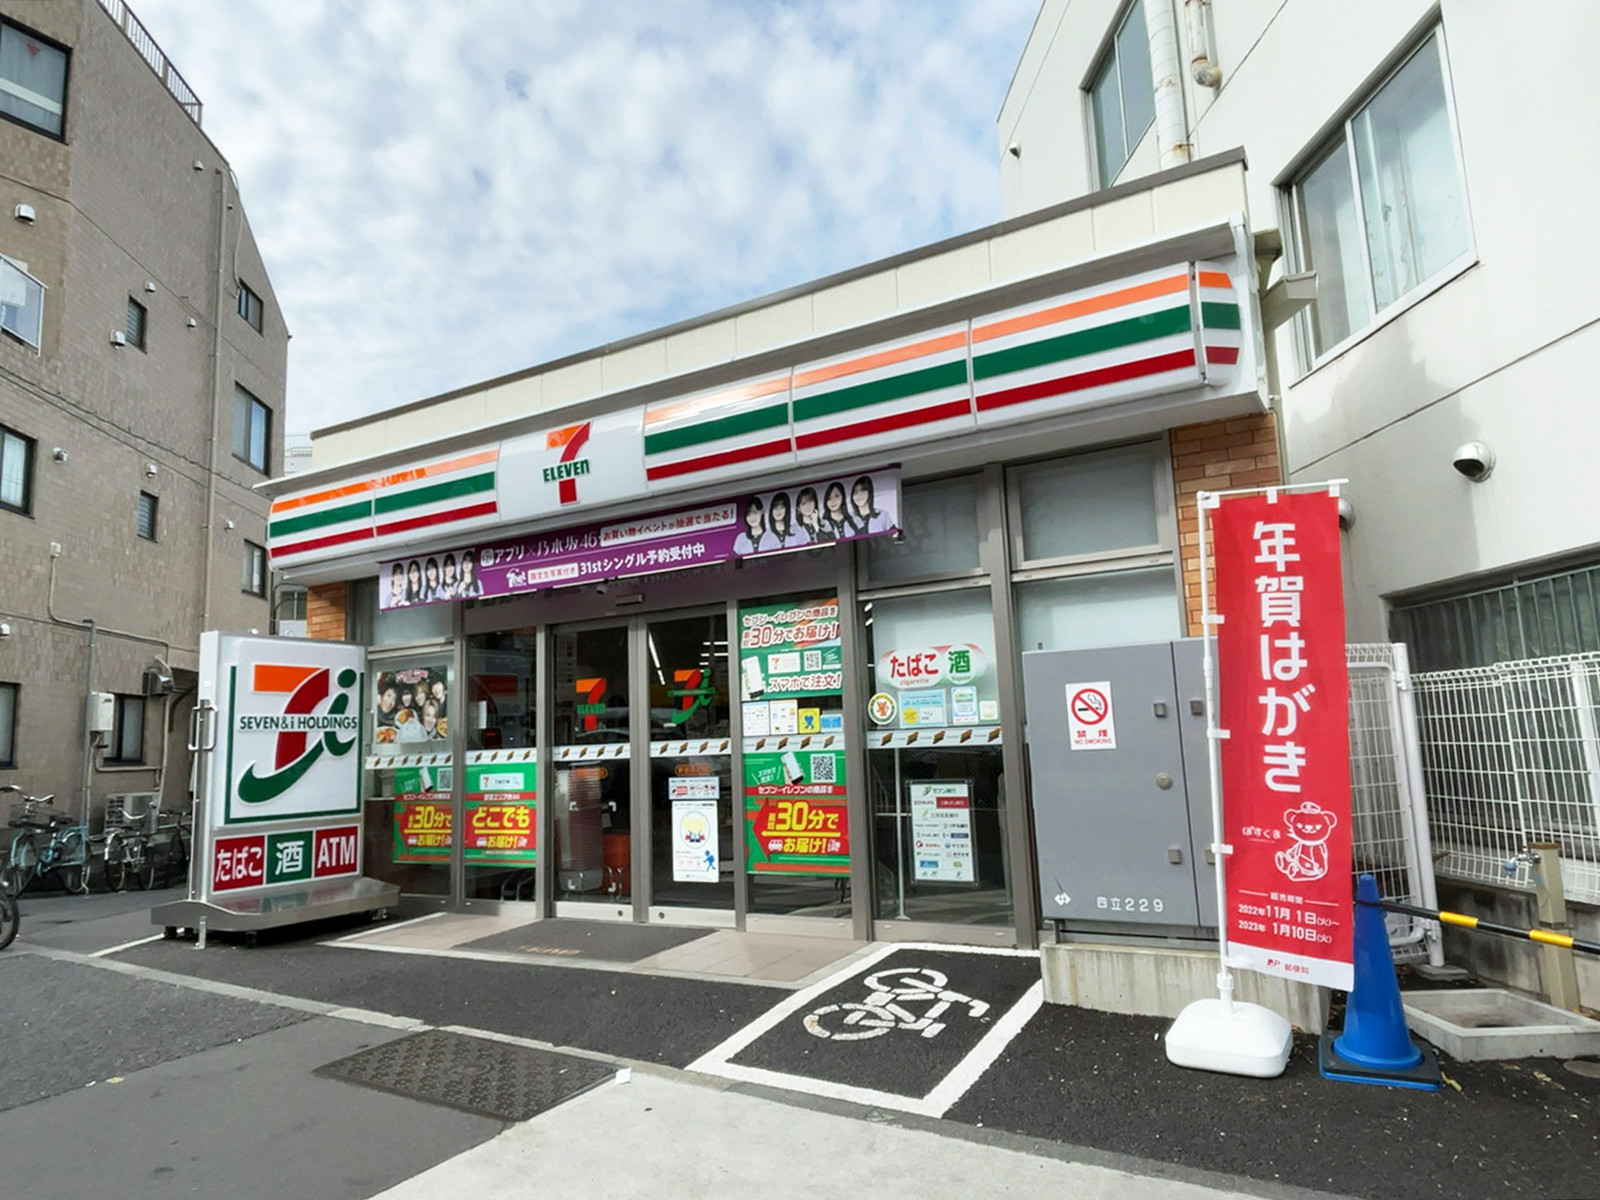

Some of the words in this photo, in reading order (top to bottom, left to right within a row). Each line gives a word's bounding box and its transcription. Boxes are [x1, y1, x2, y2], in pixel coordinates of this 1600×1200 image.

[890, 653, 938, 678] たばこ
[948, 650, 971, 673] 酒
[1252, 520, 1316, 794] 年賀はがき
[299, 716, 358, 730] HOLDINGS
[472, 806, 530, 828] どこでも
[783, 838, 826, 853] お届け!
[215, 845, 262, 882] たばこ
[275, 840, 304, 876] 酒
[317, 835, 355, 869] ATM
